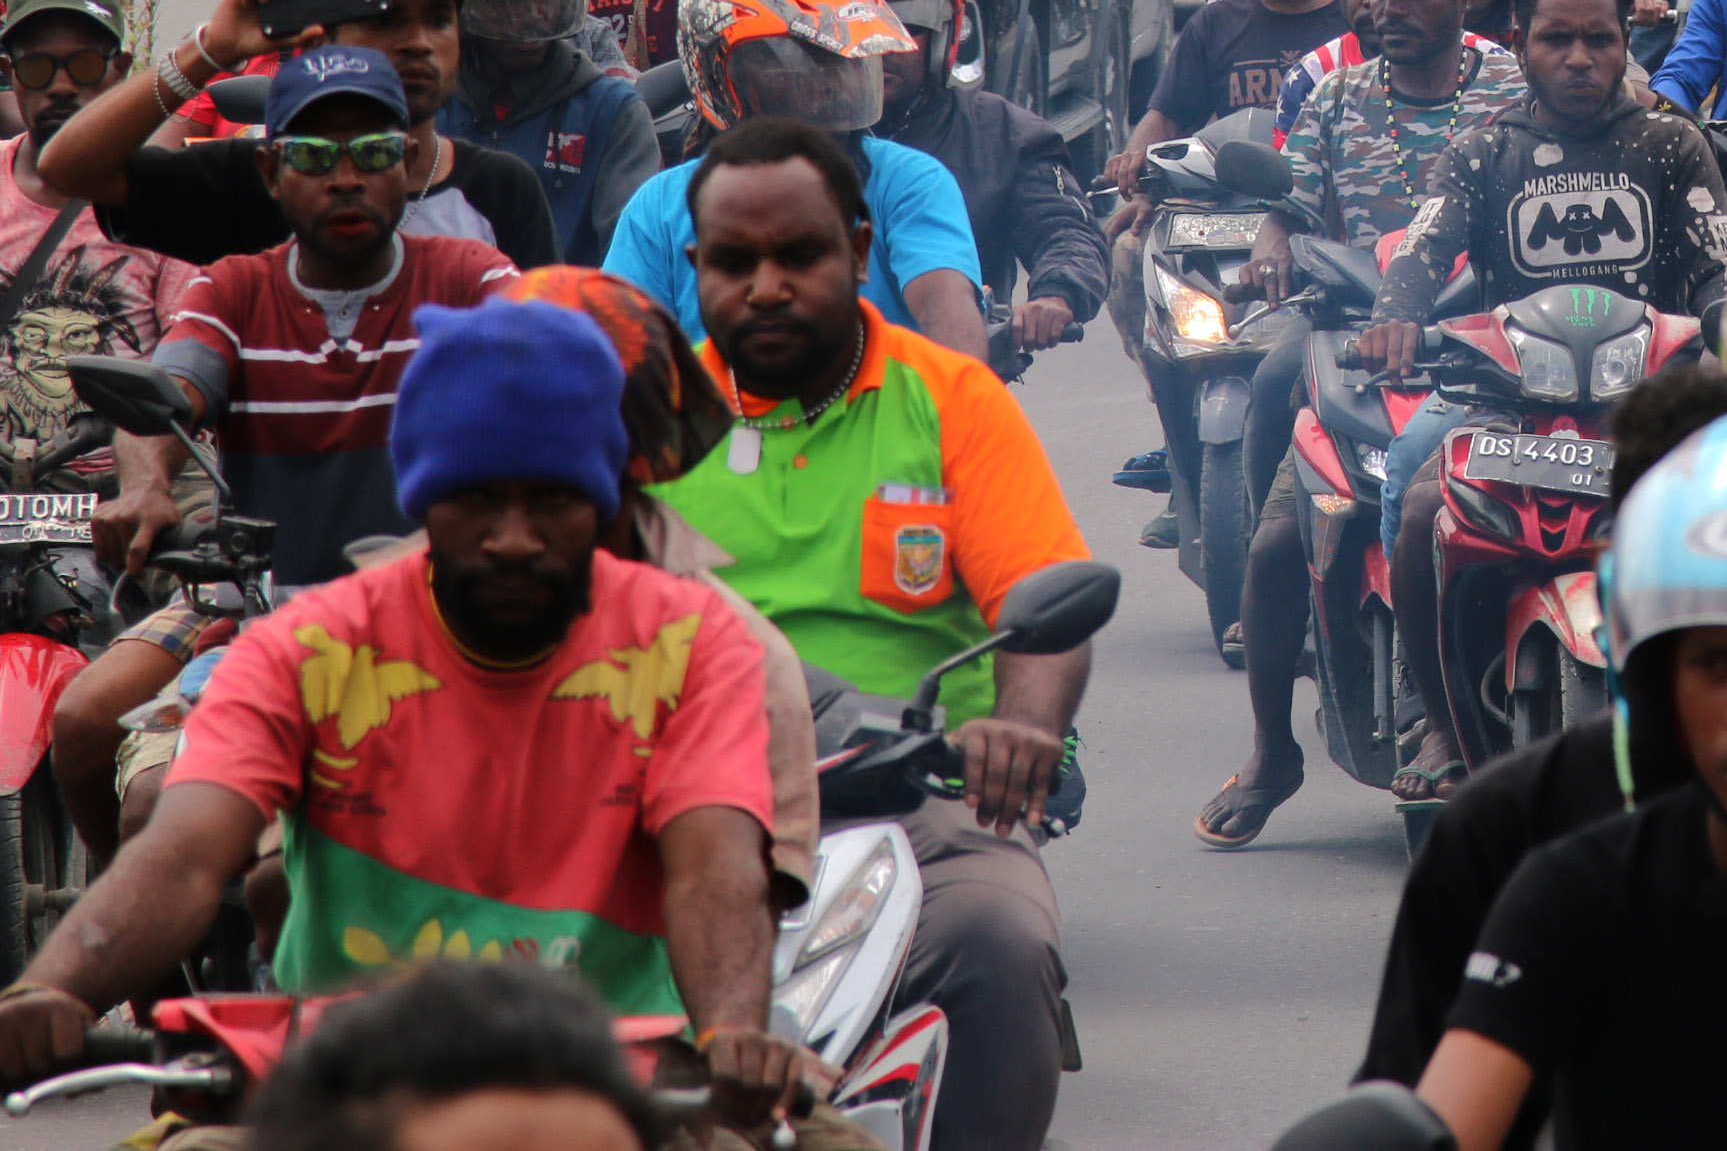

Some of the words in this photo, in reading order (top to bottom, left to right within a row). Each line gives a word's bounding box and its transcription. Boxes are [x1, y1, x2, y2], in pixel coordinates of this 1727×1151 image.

[1524, 172, 1631, 198] MARSHMELLO
[1552, 264, 1618, 280] MELLOGANG
[1478, 436, 1513, 457] DS
[1523, 440, 1595, 467] 4403
[1571, 473, 1593, 487] 01
